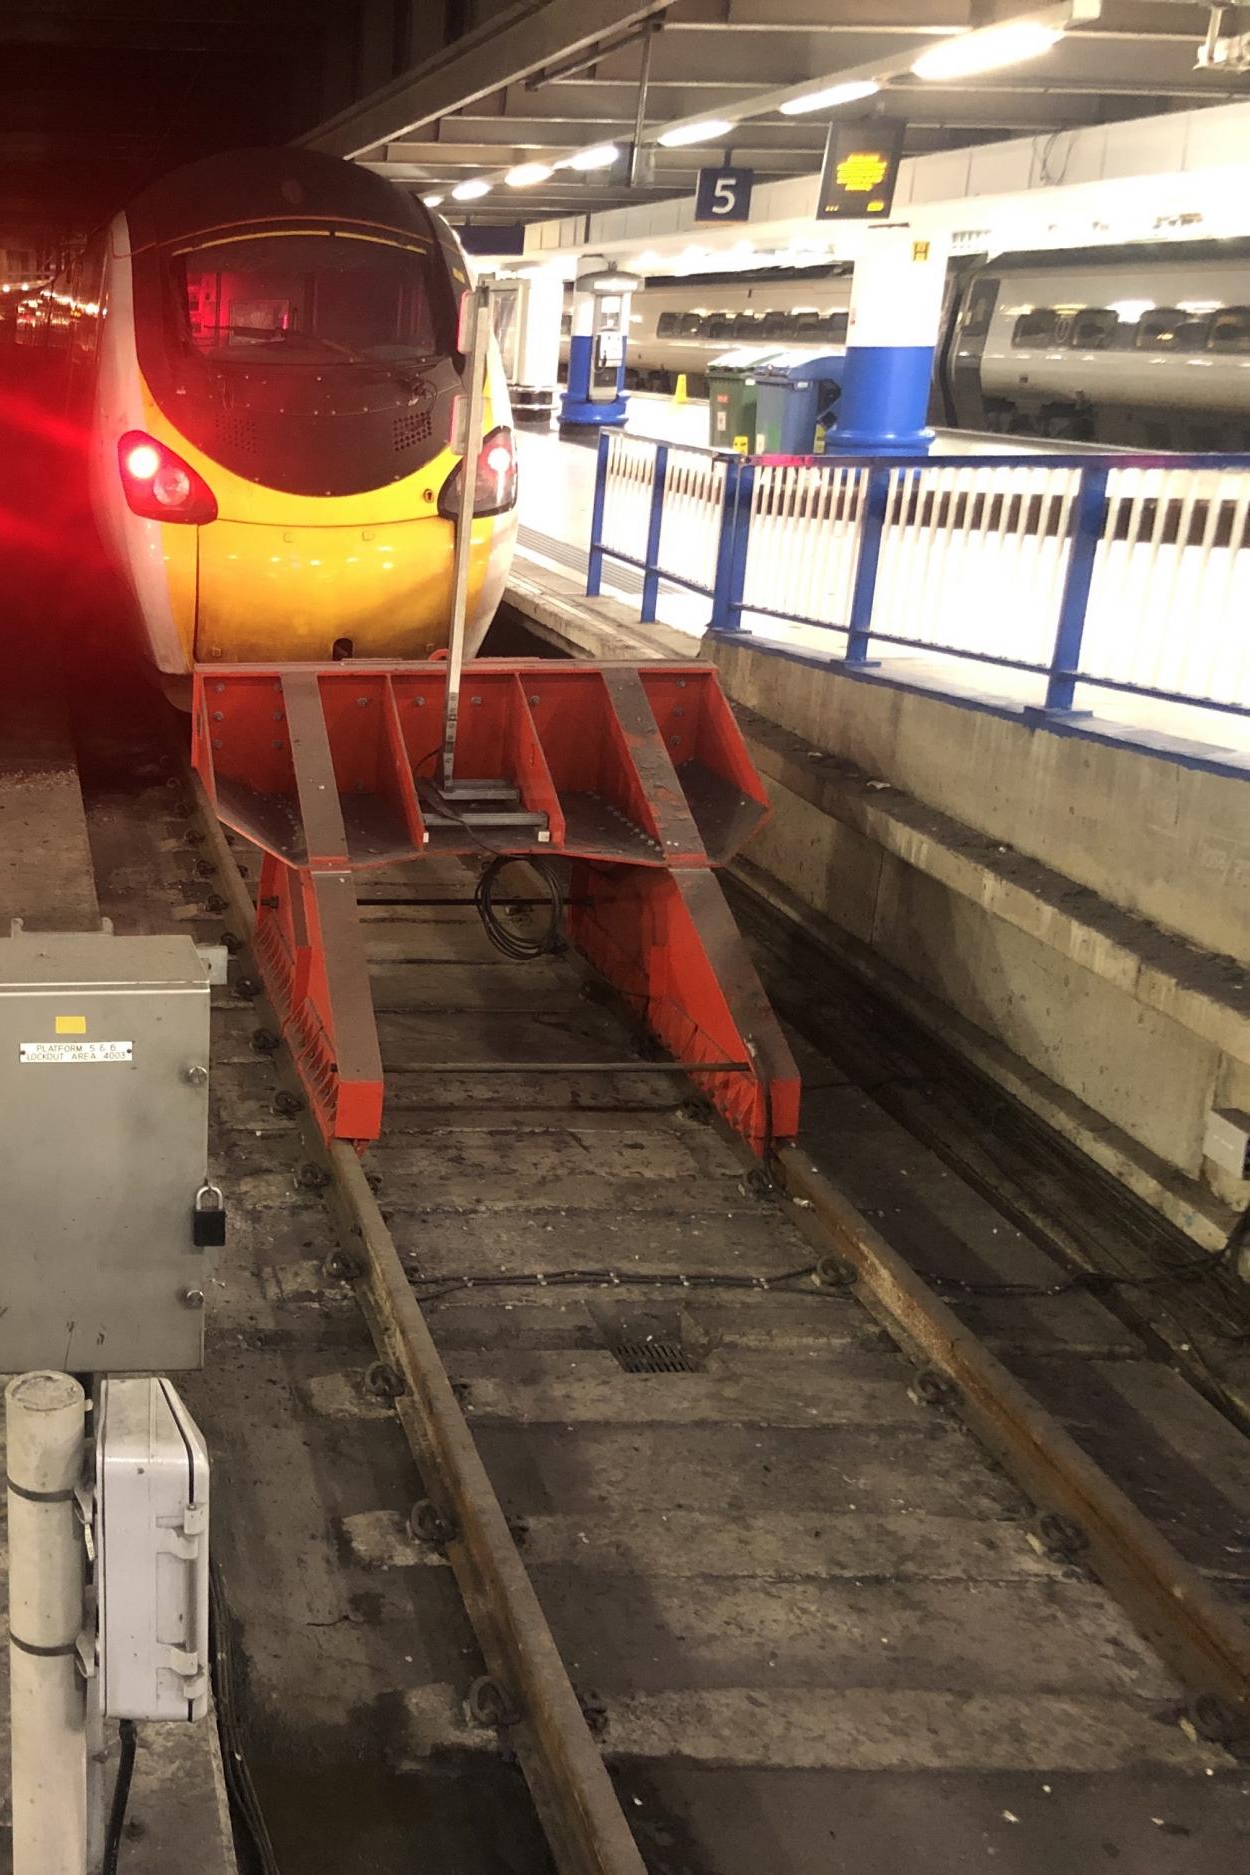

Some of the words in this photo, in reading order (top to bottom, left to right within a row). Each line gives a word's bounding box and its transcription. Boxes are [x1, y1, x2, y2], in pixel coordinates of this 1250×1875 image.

[712, 178, 737, 215] 5
[36, 1044, 83, 1053] PLATFORM
[89, 1044, 96, 1052] 5
[110, 1043, 117, 1052] 6
[26, 1052, 64, 1061] LOCKOUT
[71, 1052, 97, 1061] AREA
[103, 1051, 126, 1060] 4003
